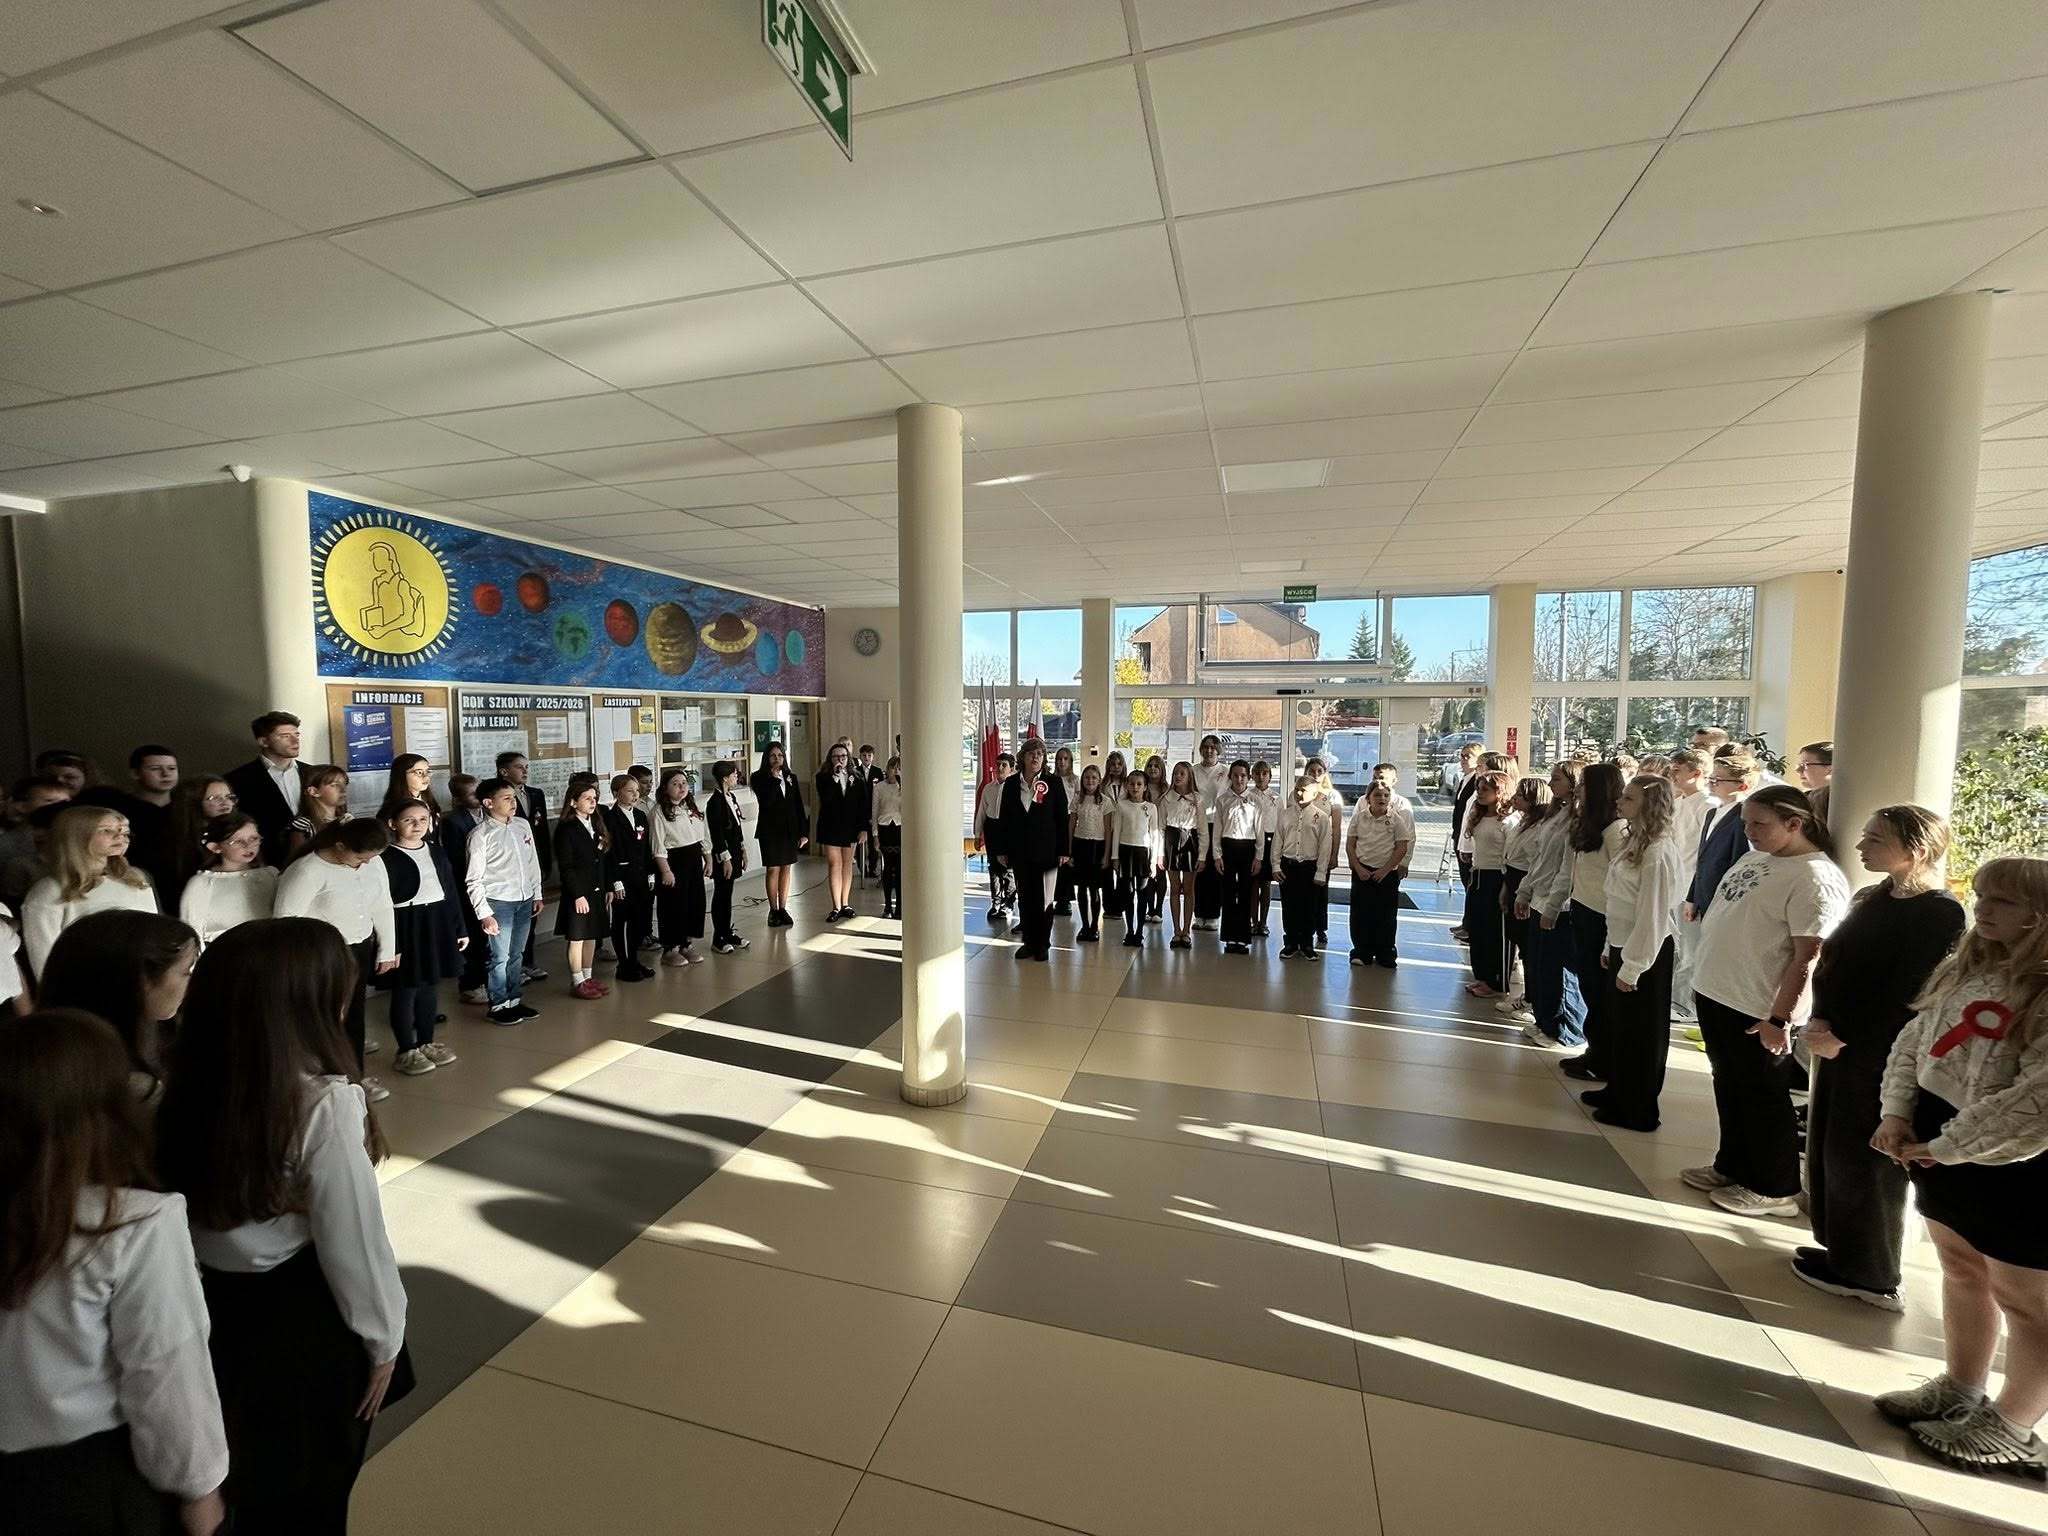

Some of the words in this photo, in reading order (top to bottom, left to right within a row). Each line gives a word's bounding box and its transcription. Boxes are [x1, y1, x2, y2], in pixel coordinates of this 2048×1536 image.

[355, 692, 422, 704] INFORMACJE
[463, 696, 484, 708] ROK
[489, 696, 531, 709] SZKOLNY
[536, 698, 584, 709] 2025/2026
[463, 716, 486, 728] PLAN
[489, 716, 518, 727] LEKCJI
